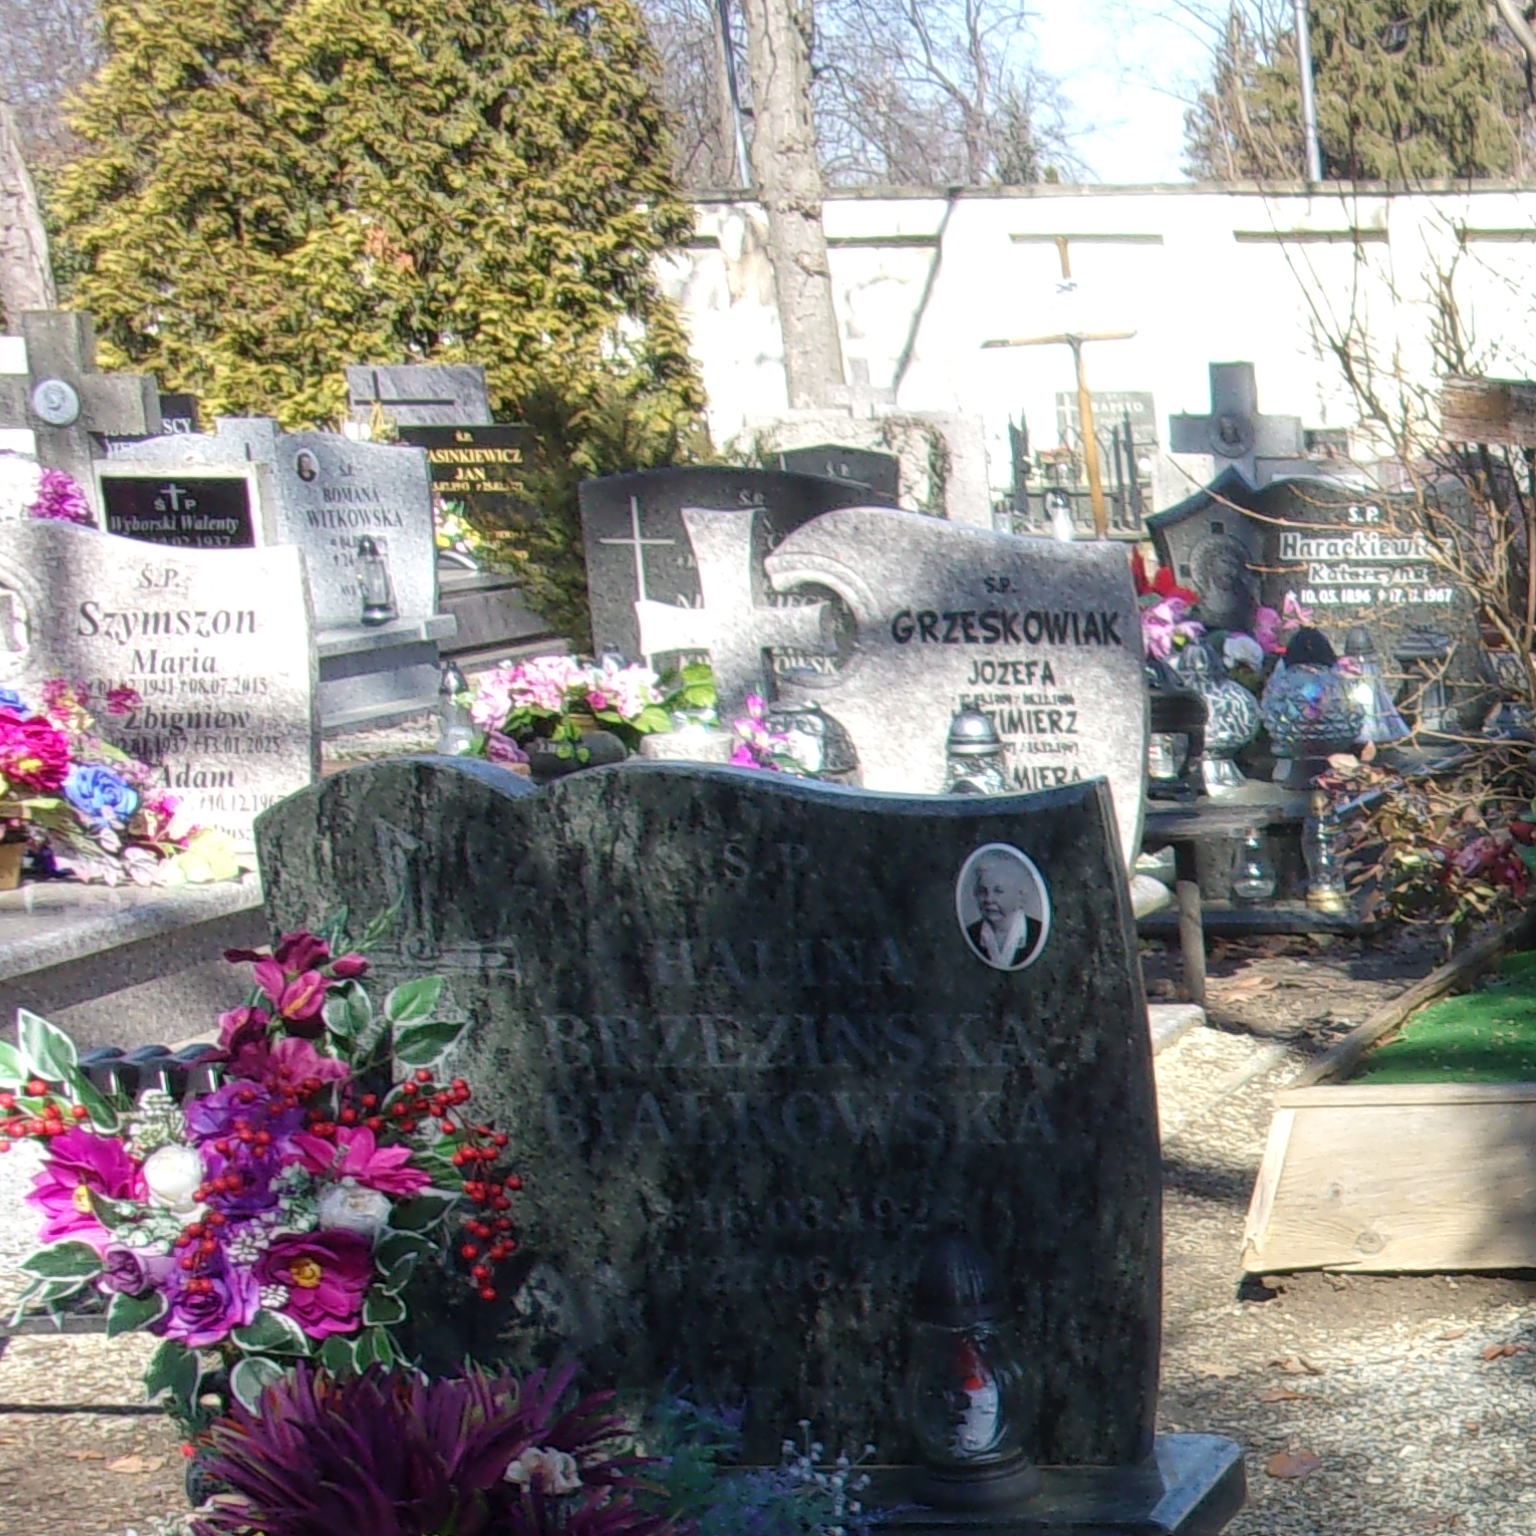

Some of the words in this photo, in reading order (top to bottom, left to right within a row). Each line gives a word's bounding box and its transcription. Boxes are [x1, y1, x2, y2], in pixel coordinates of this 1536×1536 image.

[425, 449, 523, 463] ASINKIEWICZ
[455, 467, 486, 480] JAN
[322, 488, 381, 503] ROMANA
[110, 515, 176, 536] Wyborski
[181, 515, 240, 534] Walenty
[306, 507, 404, 528] WITKOWSKA
[1280, 530, 1453, 560] Harackiewiz
[77, 601, 257, 645] Szymszon
[130, 648, 218, 674] Maria
[124, 705, 251, 734] Zbigniew
[153, 763, 235, 788] Adam
[653, 937, 915, 987] HALINA
